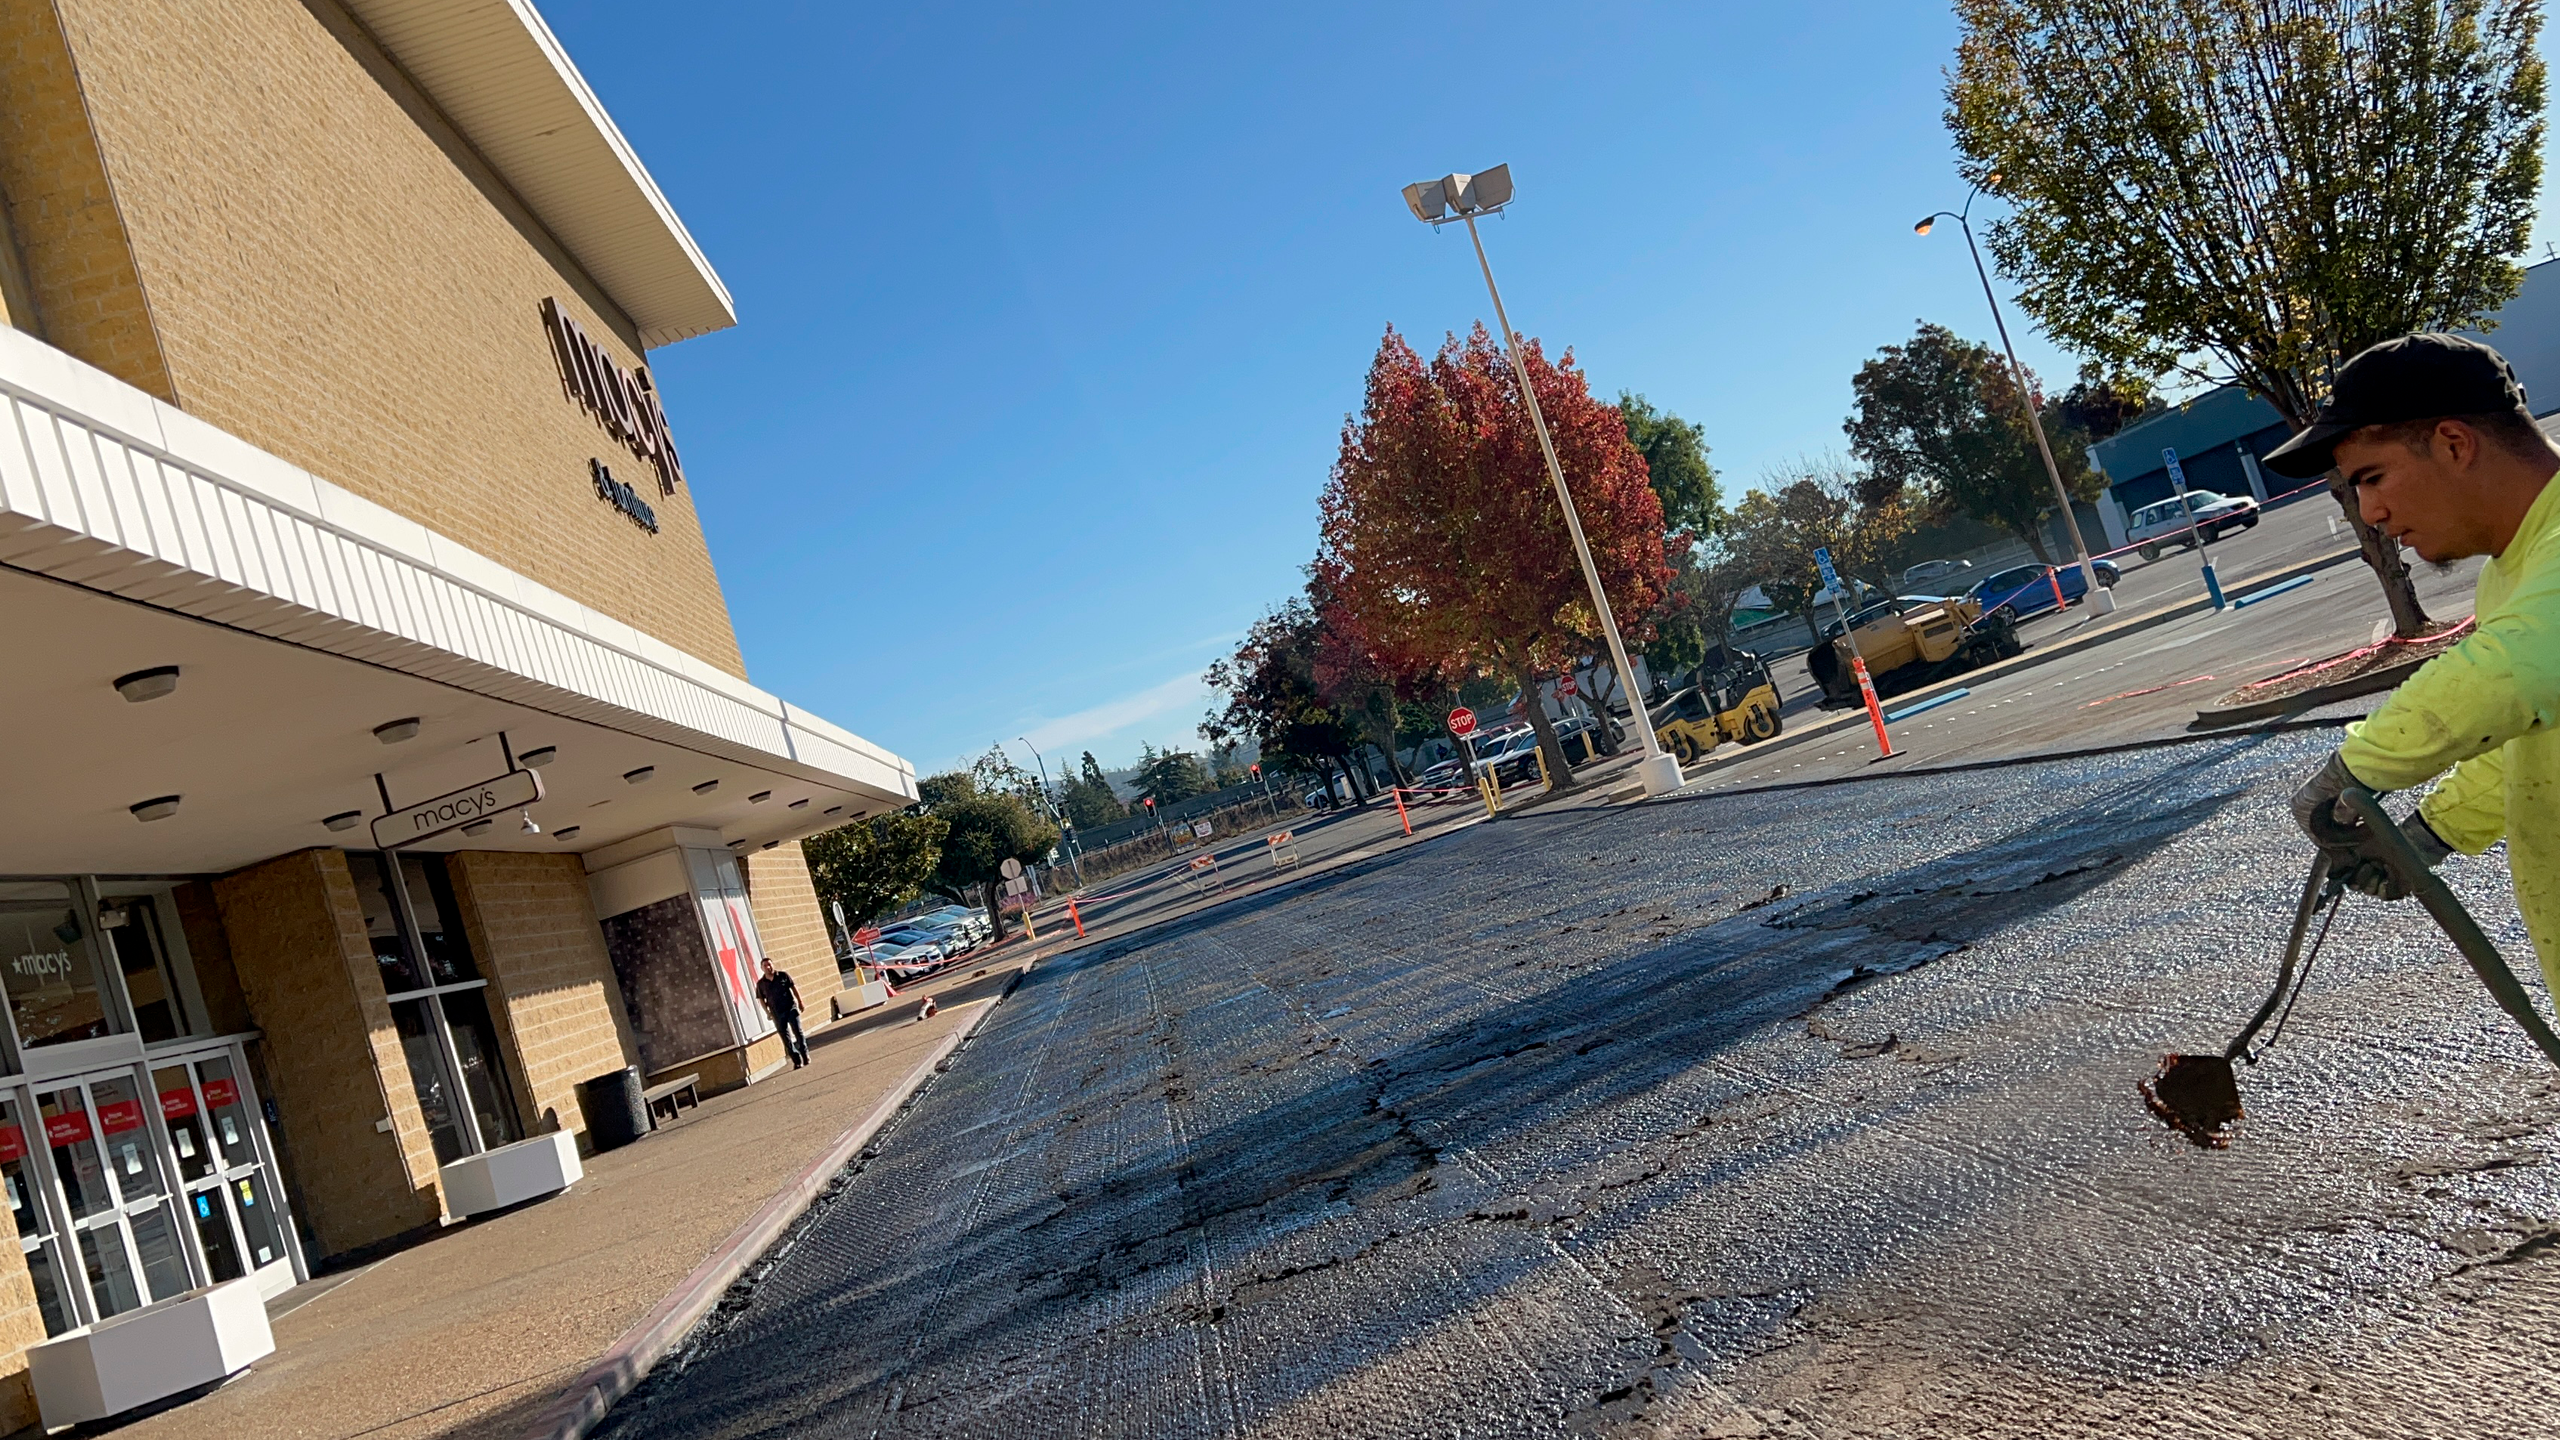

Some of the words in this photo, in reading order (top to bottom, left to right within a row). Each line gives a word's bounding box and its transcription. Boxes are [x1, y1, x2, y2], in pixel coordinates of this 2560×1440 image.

[541, 296, 683, 496] macy's
[1562, 681, 1576, 692] STOP
[1450, 713, 1473, 730] STOP
[413, 787, 496, 830] macy's
[21, 948, 72, 981] macy's
